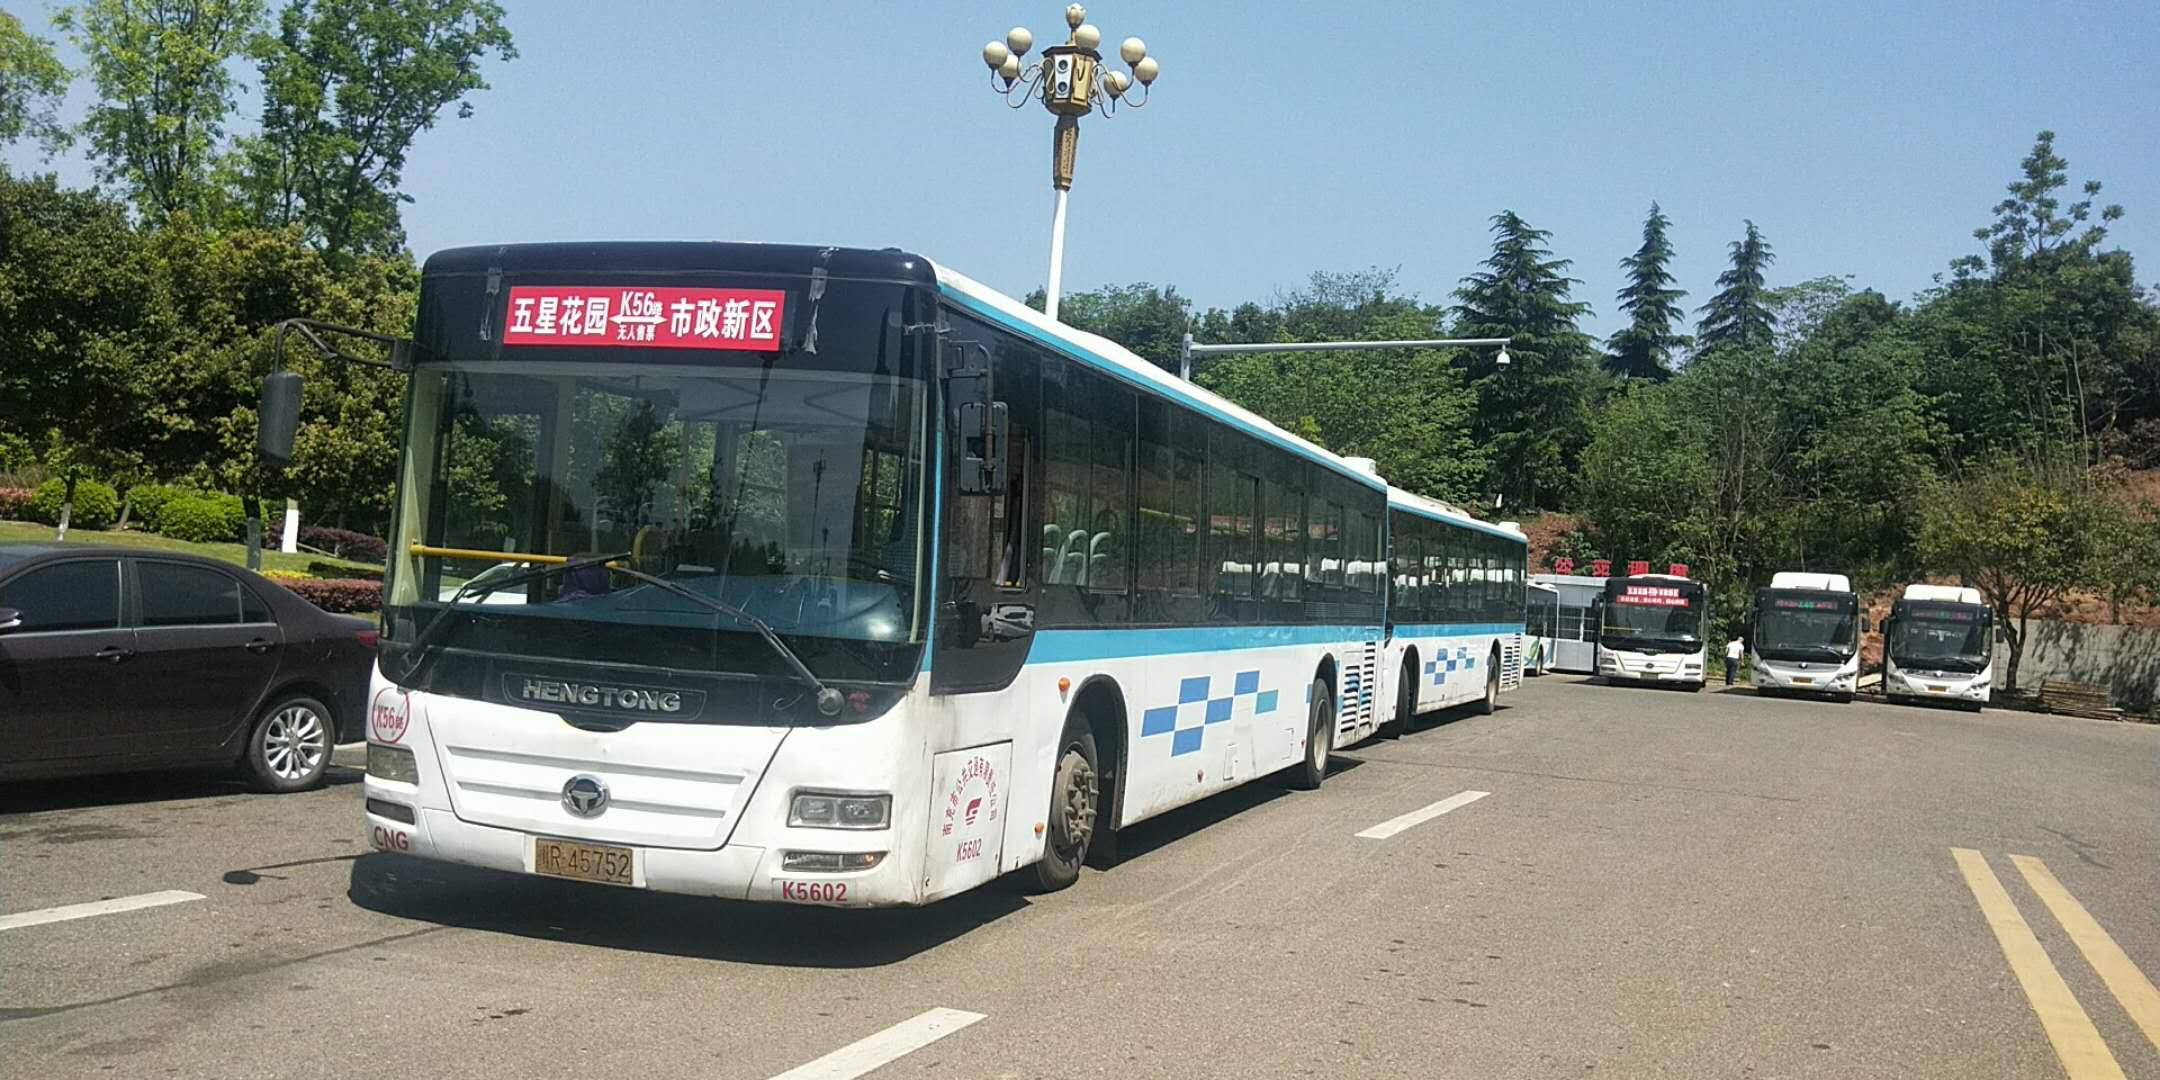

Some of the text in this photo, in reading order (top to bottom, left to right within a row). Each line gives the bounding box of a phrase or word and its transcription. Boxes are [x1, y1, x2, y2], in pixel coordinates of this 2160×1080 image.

[510, 297, 610, 336] 五星花园
[670, 298, 776, 339] 市政新区
[616, 324, 656, 341] 无人售票
[522, 679, 681, 712] HENGTONG
[374, 826, 409, 851] CNG
[956, 838, 982, 862] K5602
[782, 881, 848, 902] K5602
